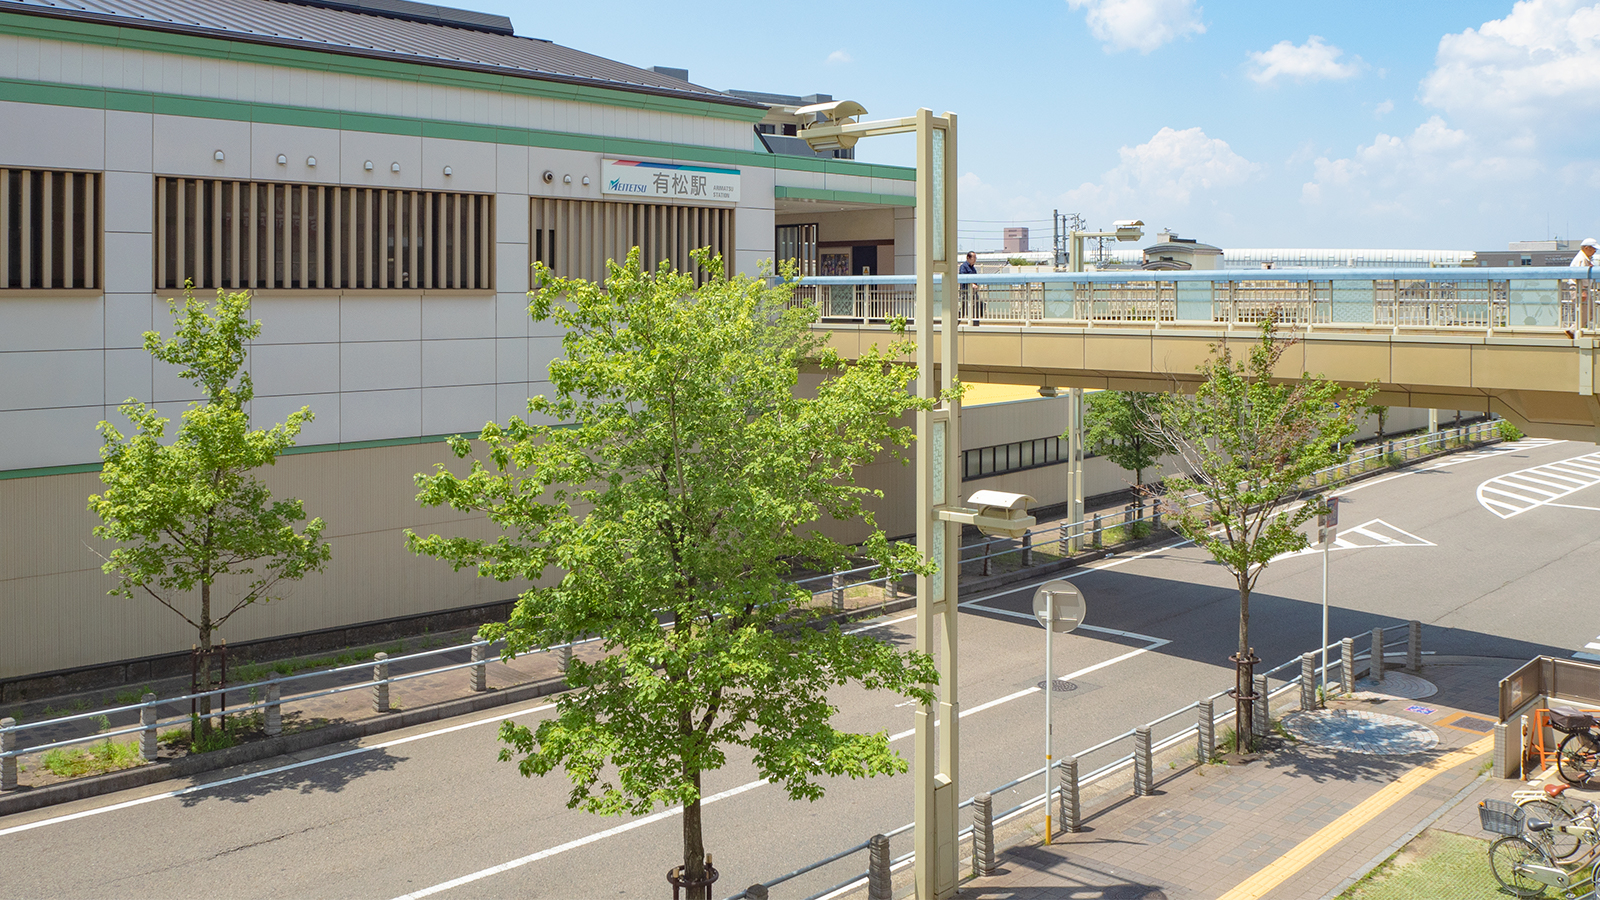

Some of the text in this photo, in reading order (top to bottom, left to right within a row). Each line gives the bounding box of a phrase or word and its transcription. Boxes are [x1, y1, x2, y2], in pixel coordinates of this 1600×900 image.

[608, 177, 647, 193] MEITETSU
[652, 172, 707, 196] 有松駅
